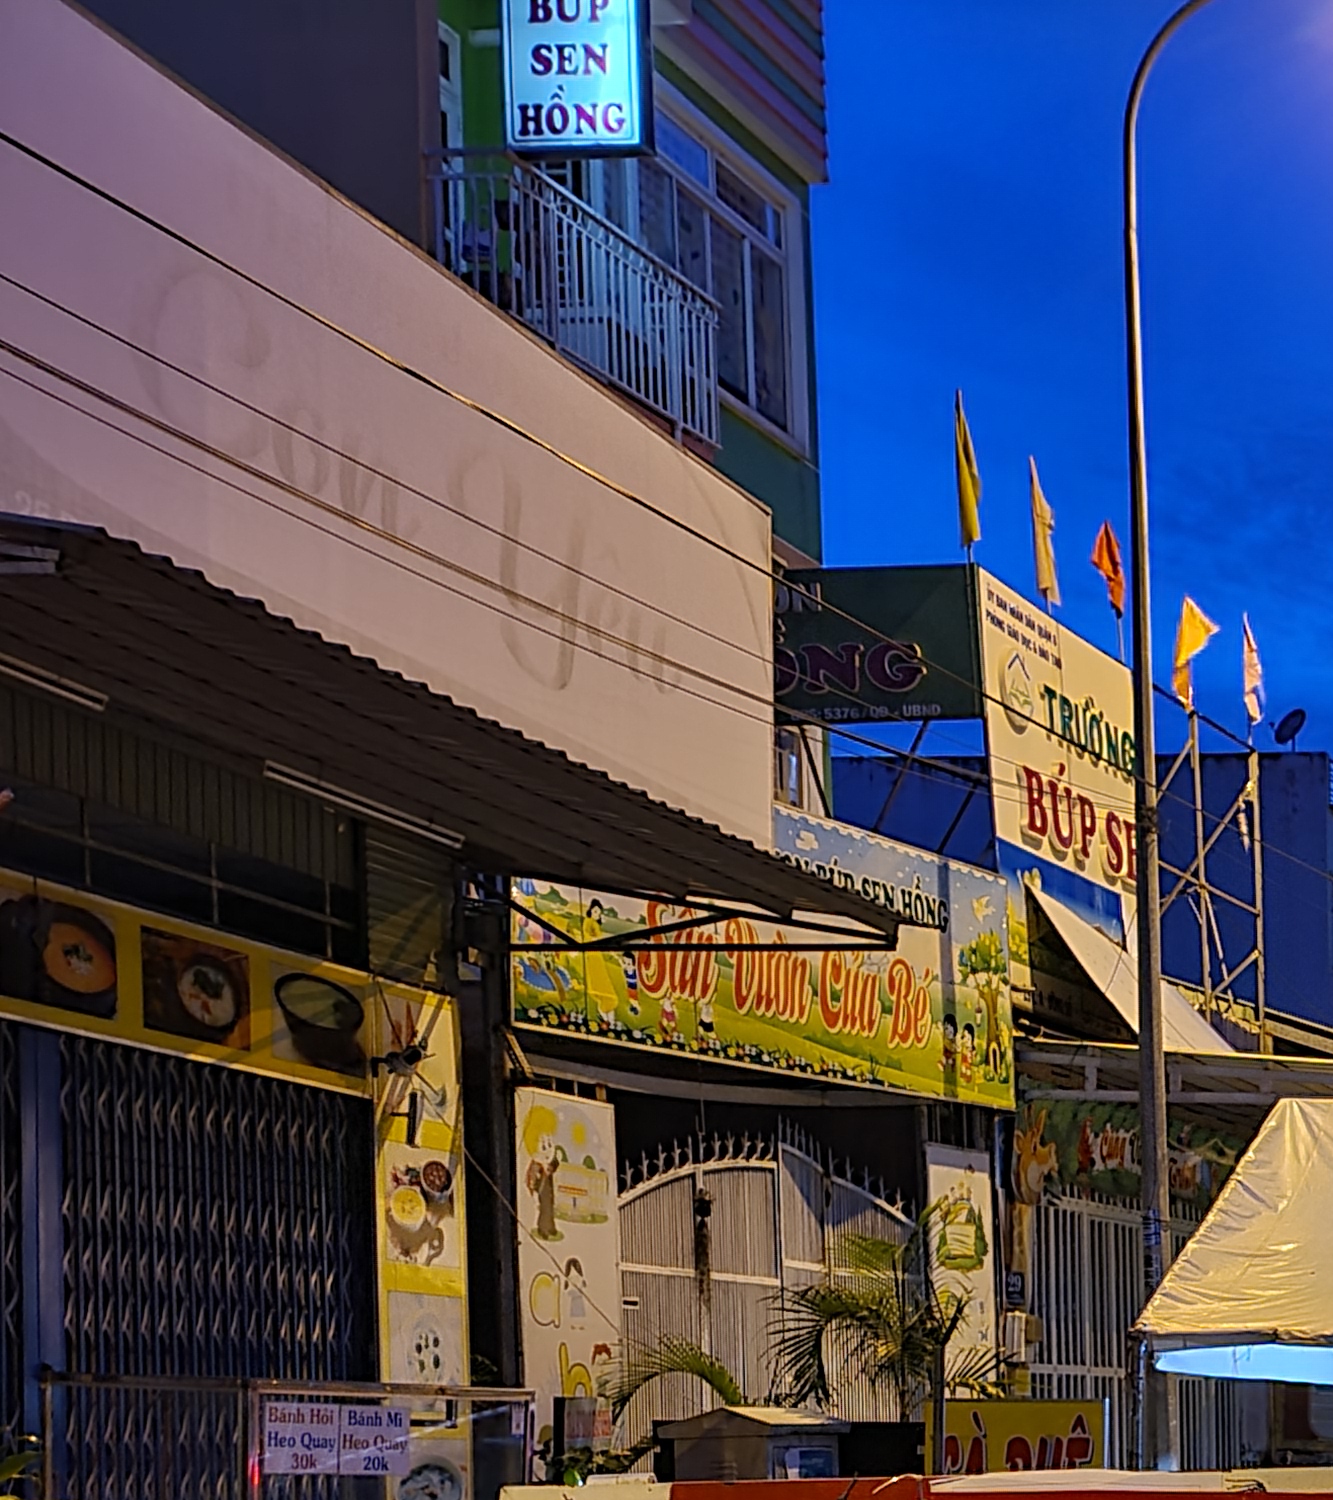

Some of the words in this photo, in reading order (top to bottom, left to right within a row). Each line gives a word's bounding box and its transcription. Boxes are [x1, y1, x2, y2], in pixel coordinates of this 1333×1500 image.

[531, 44, 608, 76] SEN
[518, 84, 625, 136] HỒNG
[1042, 684, 1136, 776] TRƯỜNG
[1023, 762, 1096, 859] BÚP
[900, 876, 949, 933] HỒNG
[887, 958, 932, 1049] Bé
[268, 1407, 305, 1424] Bánh
[348, 1410, 382, 1427] Bánh
[267, 1431, 296, 1448] Heo
[301, 1432, 336, 1452] Quay
[342, 1434, 369, 1450] Heo
[374, 1435, 407, 1453] Quay
[291, 1453, 317, 1470] 30k
[363, 1456, 389, 1471] 20k
